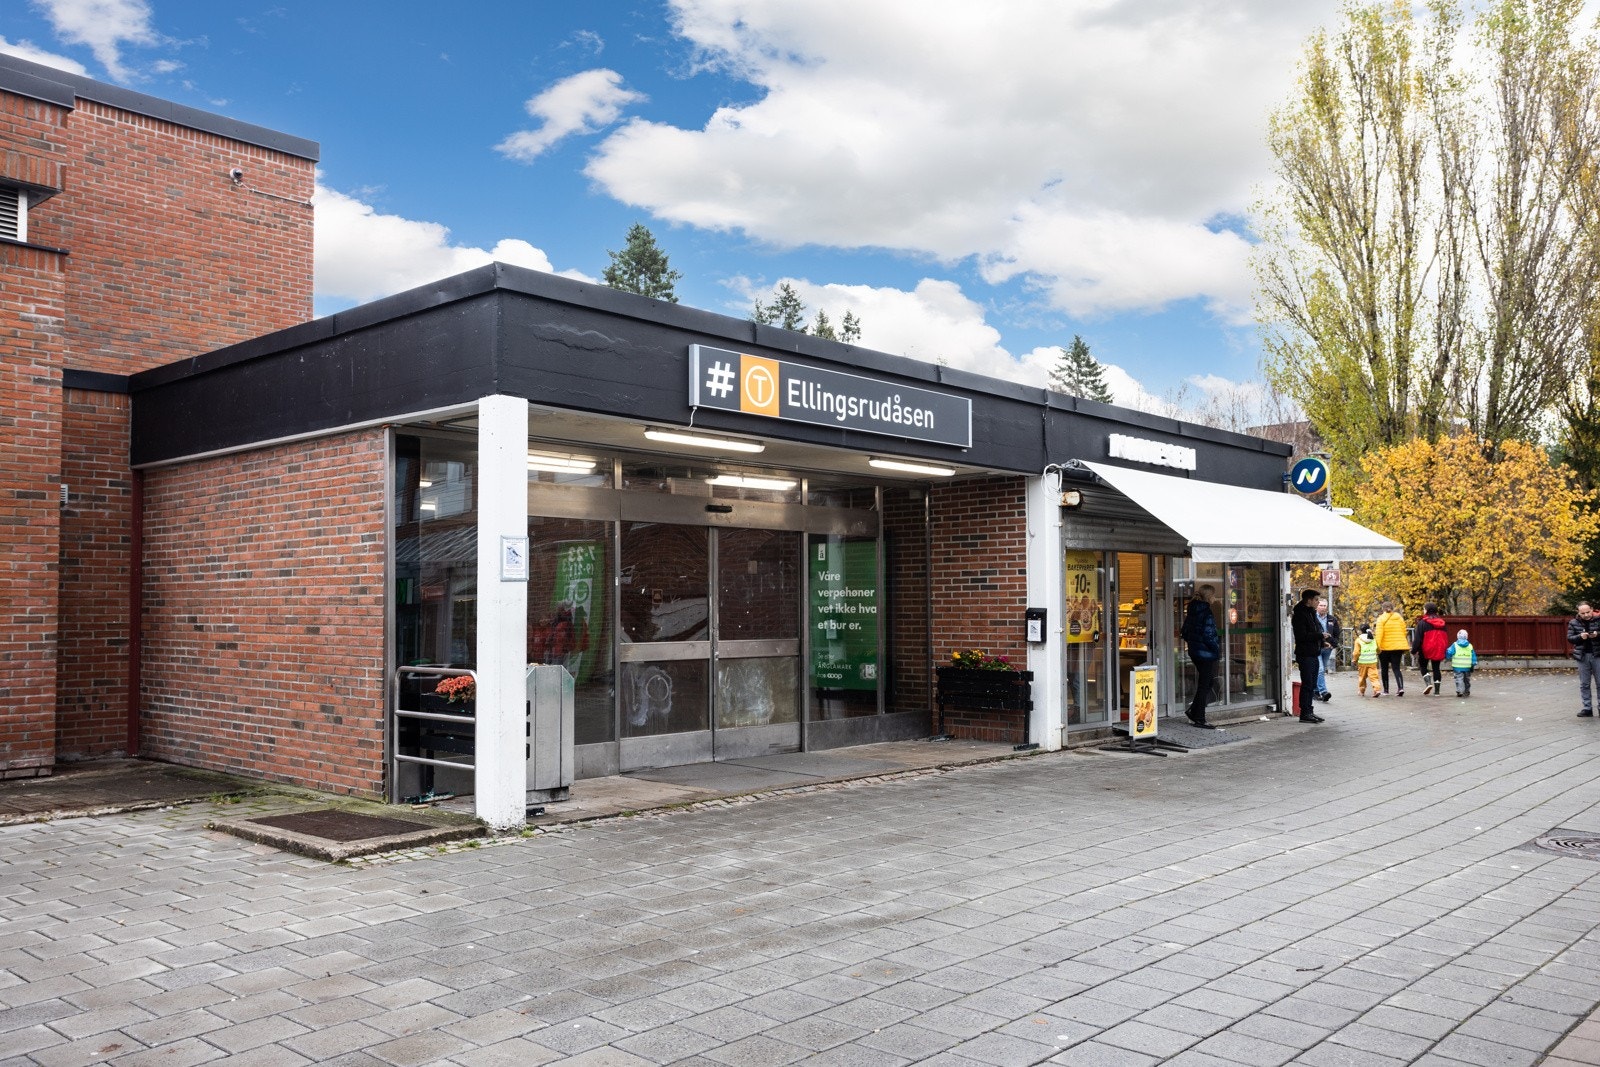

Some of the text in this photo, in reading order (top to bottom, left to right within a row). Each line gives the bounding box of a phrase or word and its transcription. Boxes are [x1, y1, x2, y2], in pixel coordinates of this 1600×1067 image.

[788, 378, 934, 429] Ellingsrudåsen
[818, 570, 841, 581] Våre
[818, 587, 875, 600] verpehøner
[818, 603, 877, 614] vet ikke hva
[818, 619, 862, 630] et bur er.
